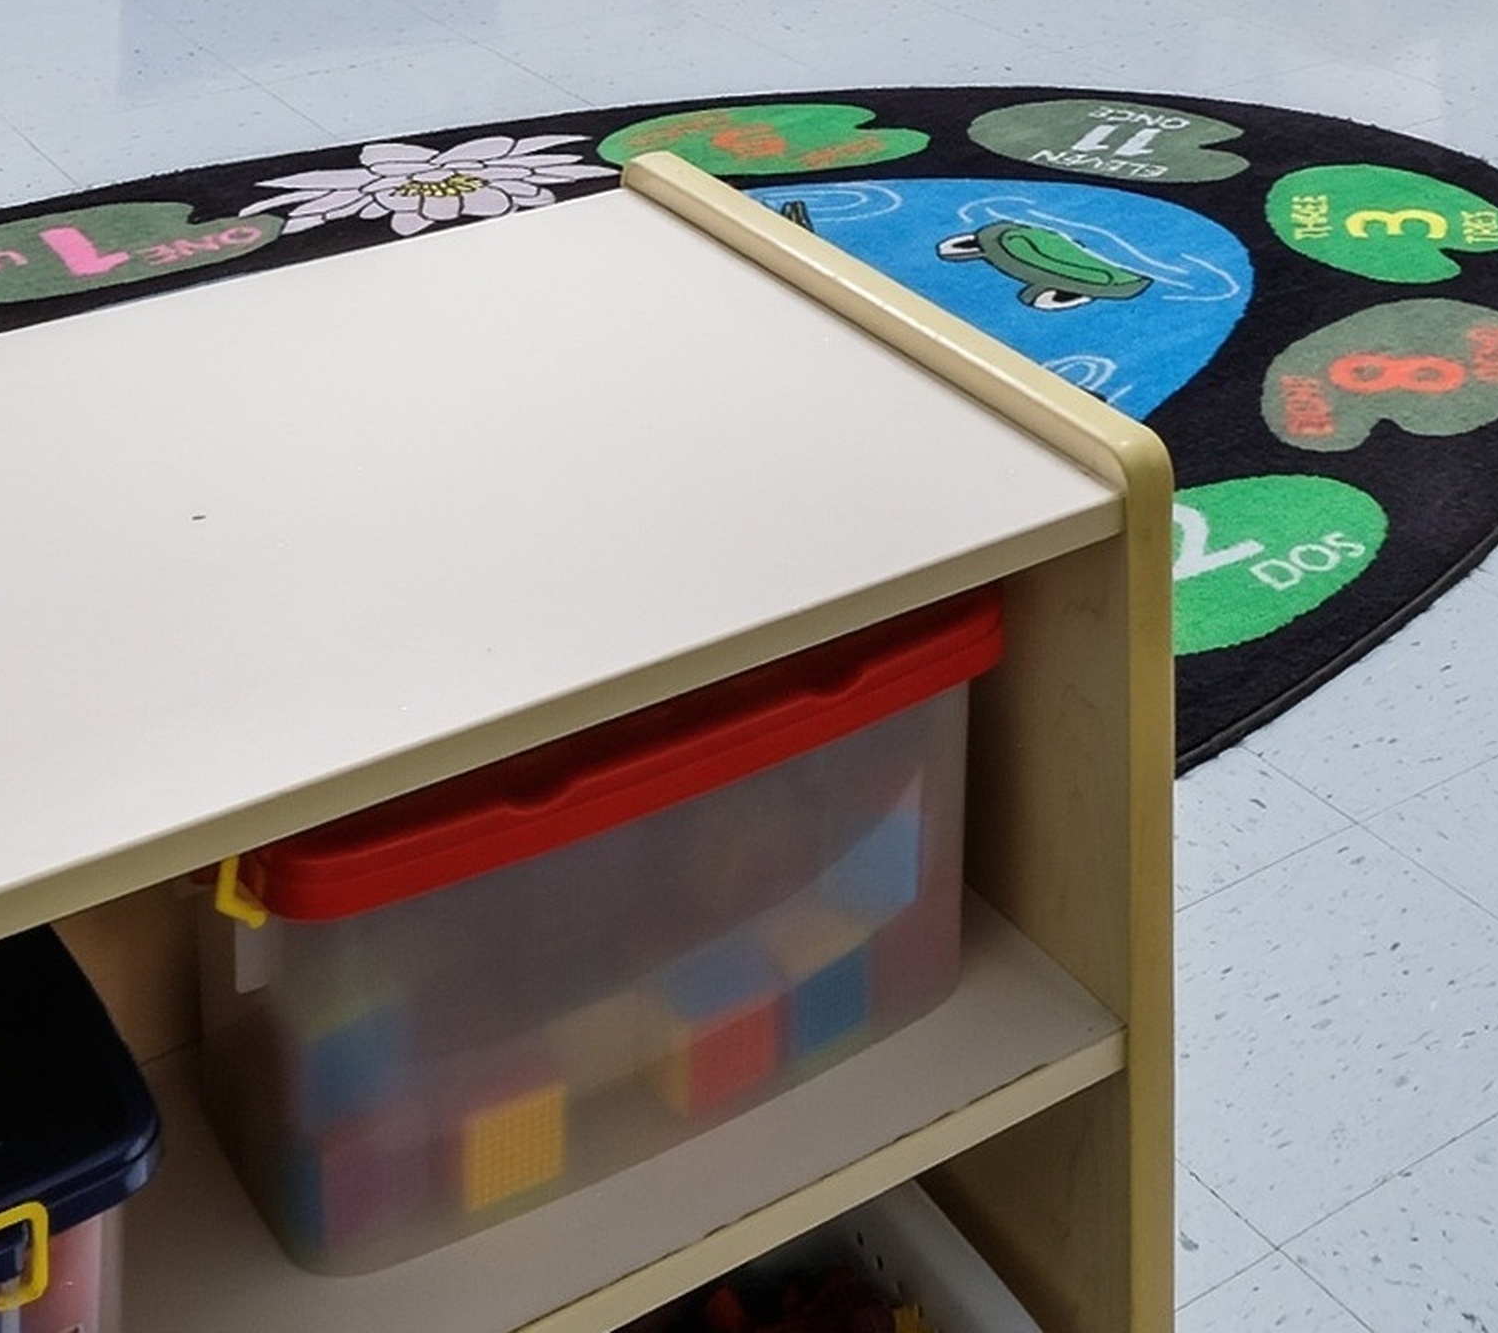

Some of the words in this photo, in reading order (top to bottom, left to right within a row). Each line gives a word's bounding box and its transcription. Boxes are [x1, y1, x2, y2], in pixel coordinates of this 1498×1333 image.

[1088, 106, 1191, 130] ONCE
[1072, 125, 1161, 156] 11
[1028, 149, 1169, 178] ELEVEN
[1345, 209, 1448, 239] 3
[39, 225, 131, 277] 1
[143, 225, 261, 267] ONE
[1328, 351, 1466, 394] 8
[1250, 531, 1366, 591] DOS
